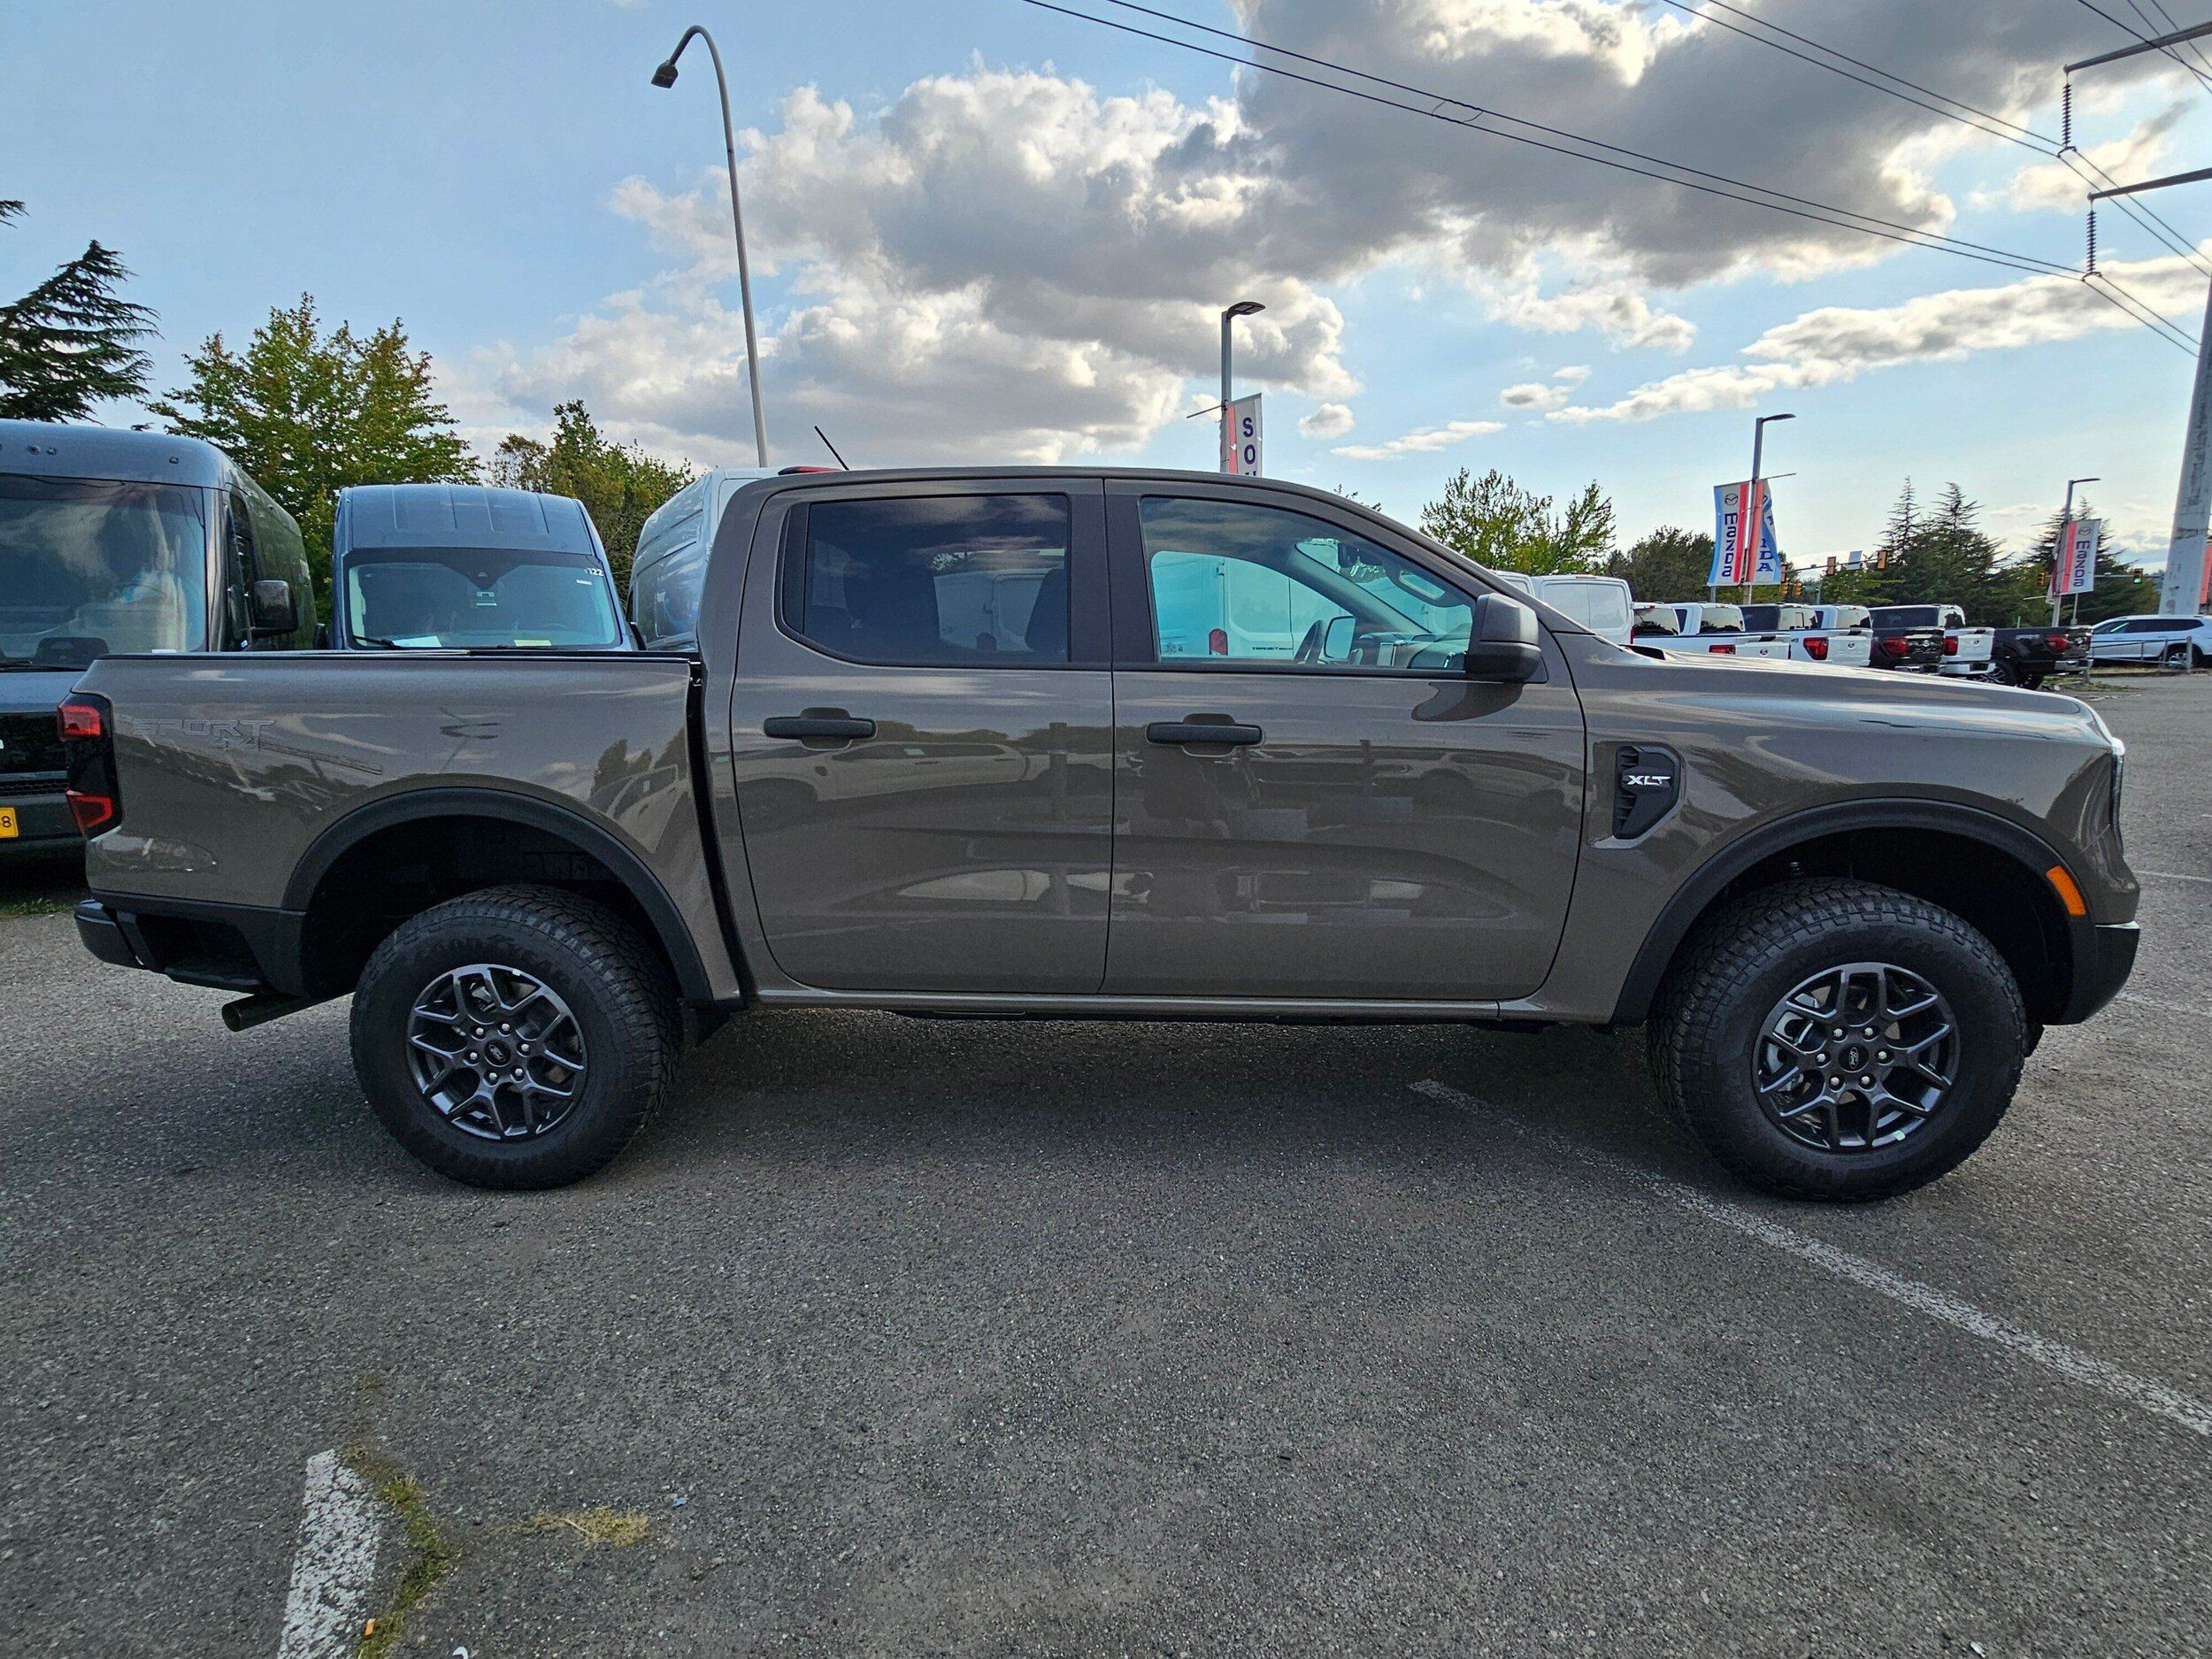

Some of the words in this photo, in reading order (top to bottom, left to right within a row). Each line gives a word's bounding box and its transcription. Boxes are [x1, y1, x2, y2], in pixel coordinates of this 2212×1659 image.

[1242, 417, 1256, 475] SO
[132, 718, 276, 736] SPORT
[1626, 775, 1671, 787] XLT
